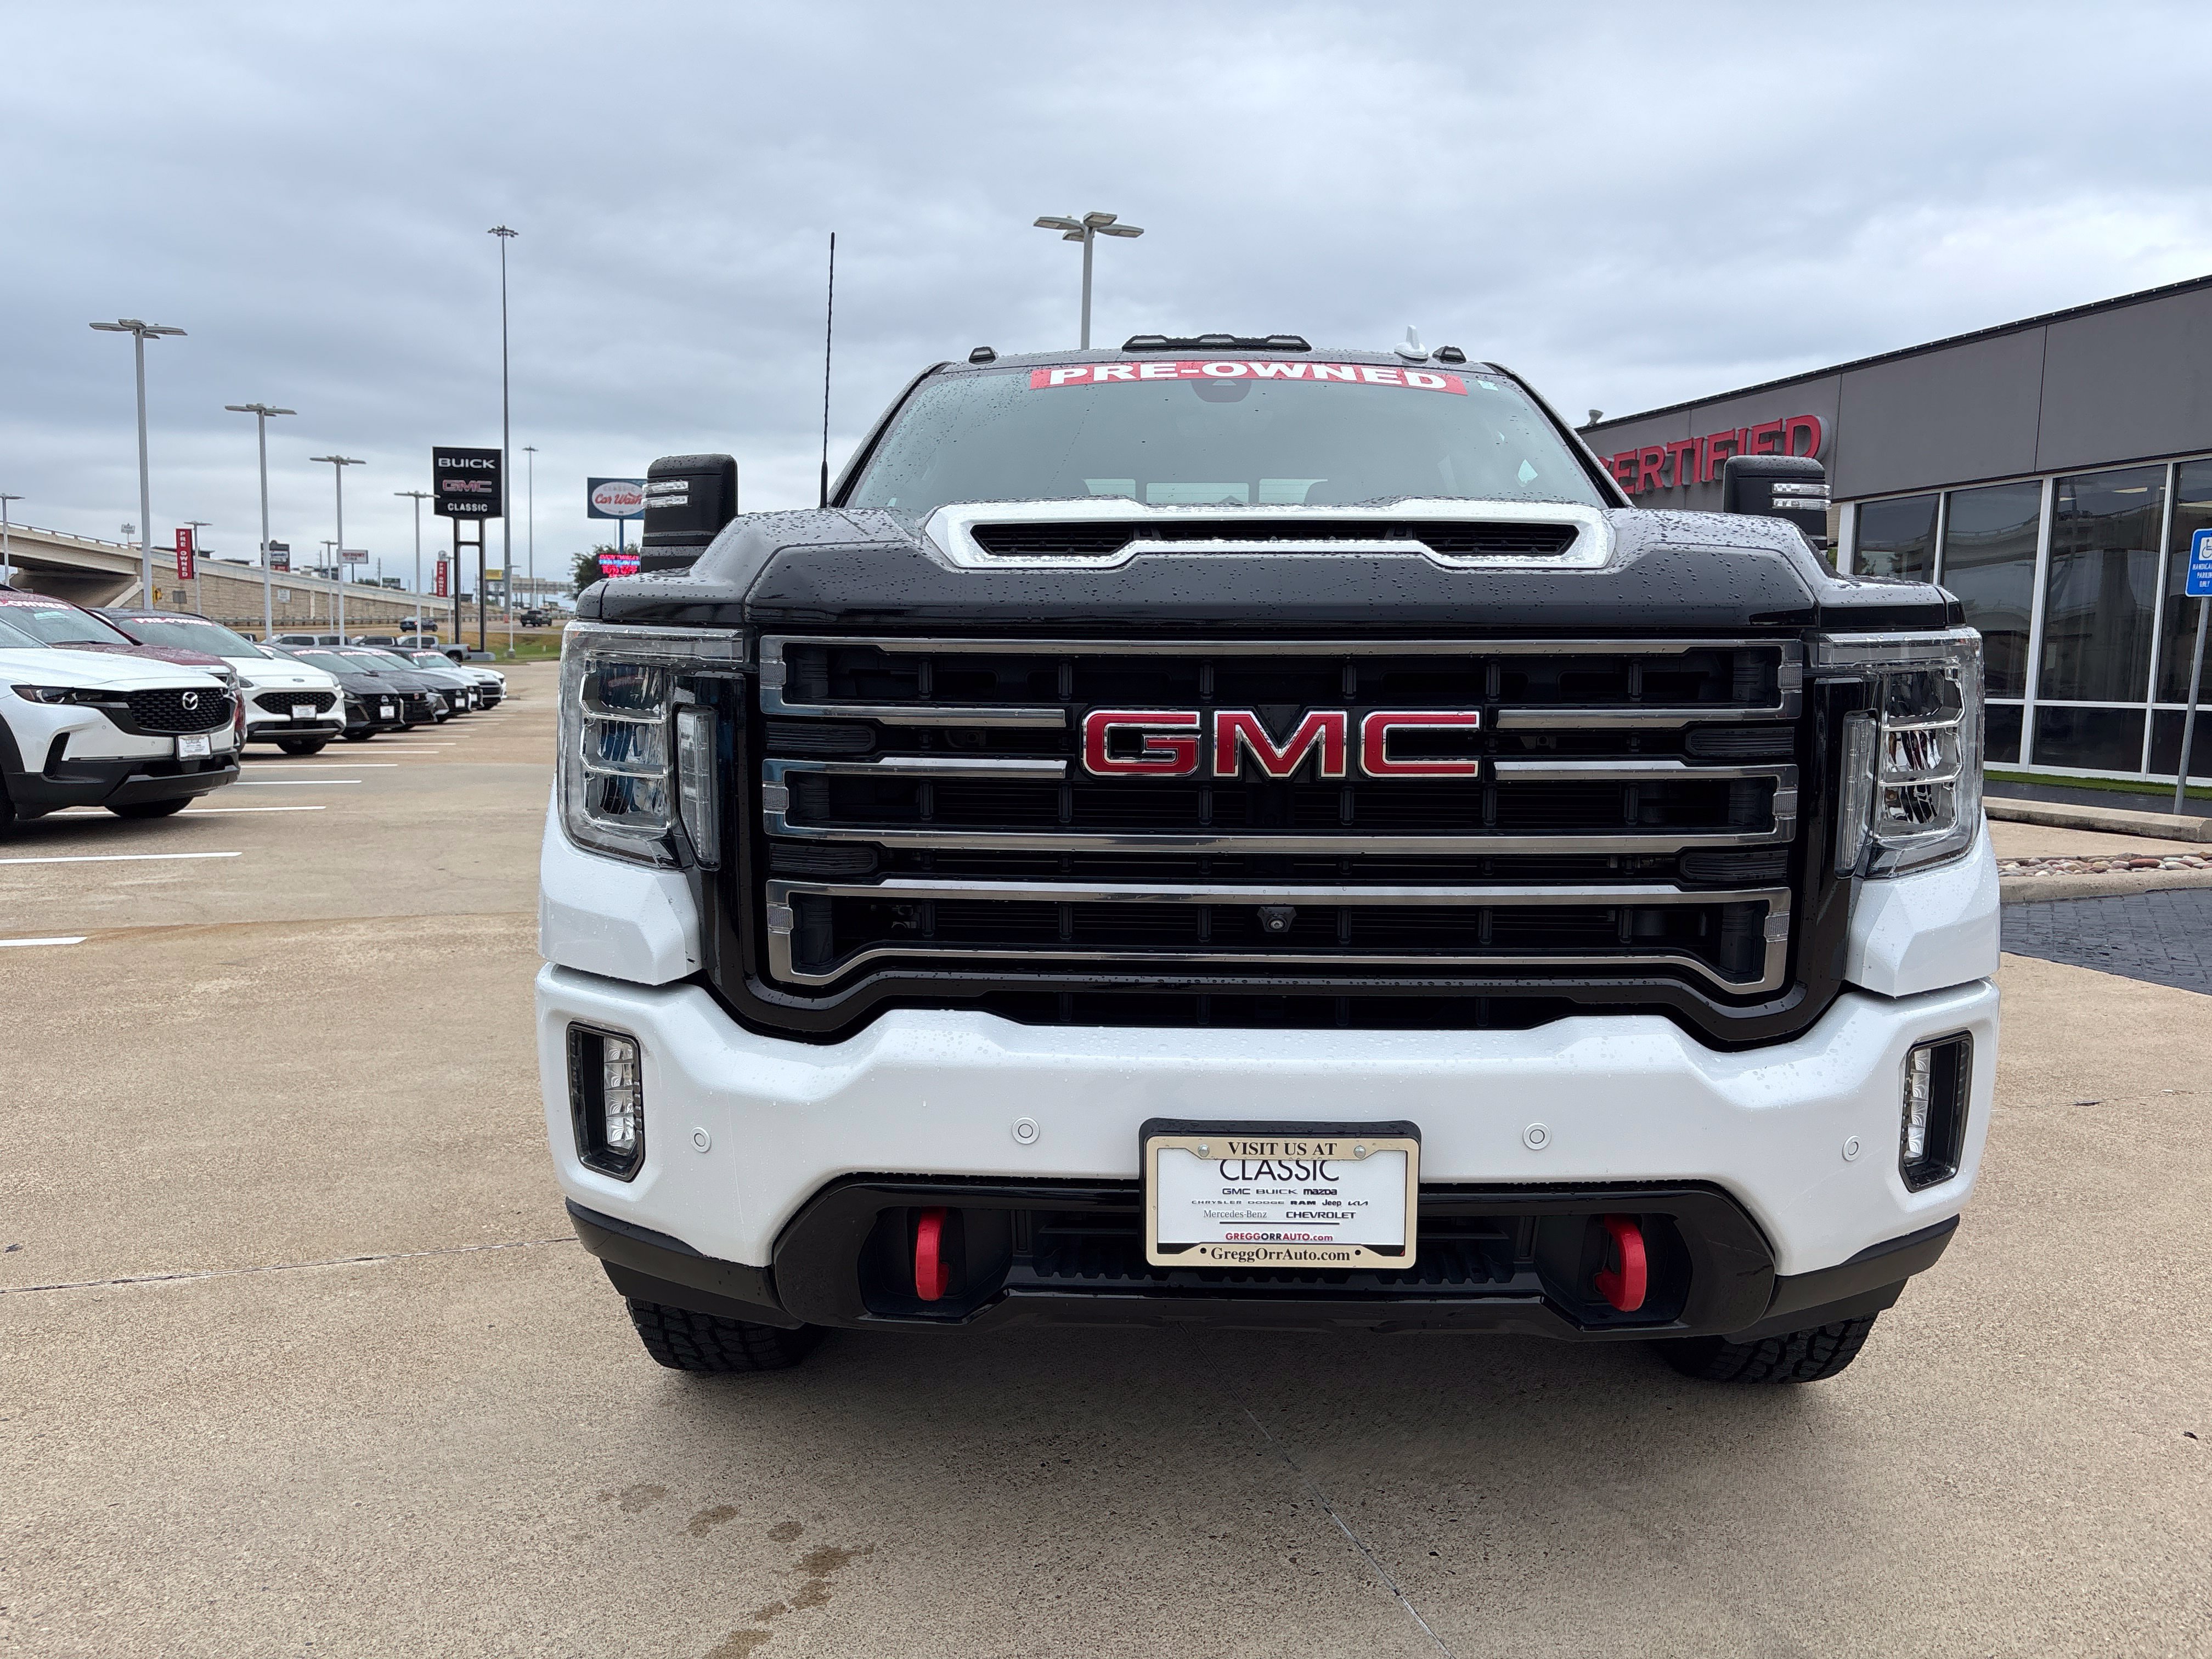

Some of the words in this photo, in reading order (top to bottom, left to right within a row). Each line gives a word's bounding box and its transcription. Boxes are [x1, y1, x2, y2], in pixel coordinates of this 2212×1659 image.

[1049, 362, 1448, 389] PRE-OWNED
[1599, 414, 1822, 494] ERTIFIED
[438, 458, 496, 469] BUICK
[442, 479, 492, 493] GMC
[595, 493, 612, 504] Car
[614, 492, 642, 505] Wash
[447, 503, 488, 512] CLASSIC
[180, 550, 188, 577] OWNED
[1082, 709, 1480, 778] GMC
[1227, 1142, 1278, 1155] VISIT
[1284, 1142, 1307, 1156] US
[1312, 1142, 1337, 1155] AT
[1220, 1159, 1339, 1181] CLASSIC
[1225, 1232, 1333, 1242] GREGGORRAUTO.com
[1211, 1247, 1350, 1263] GreggOrrAuto.com
